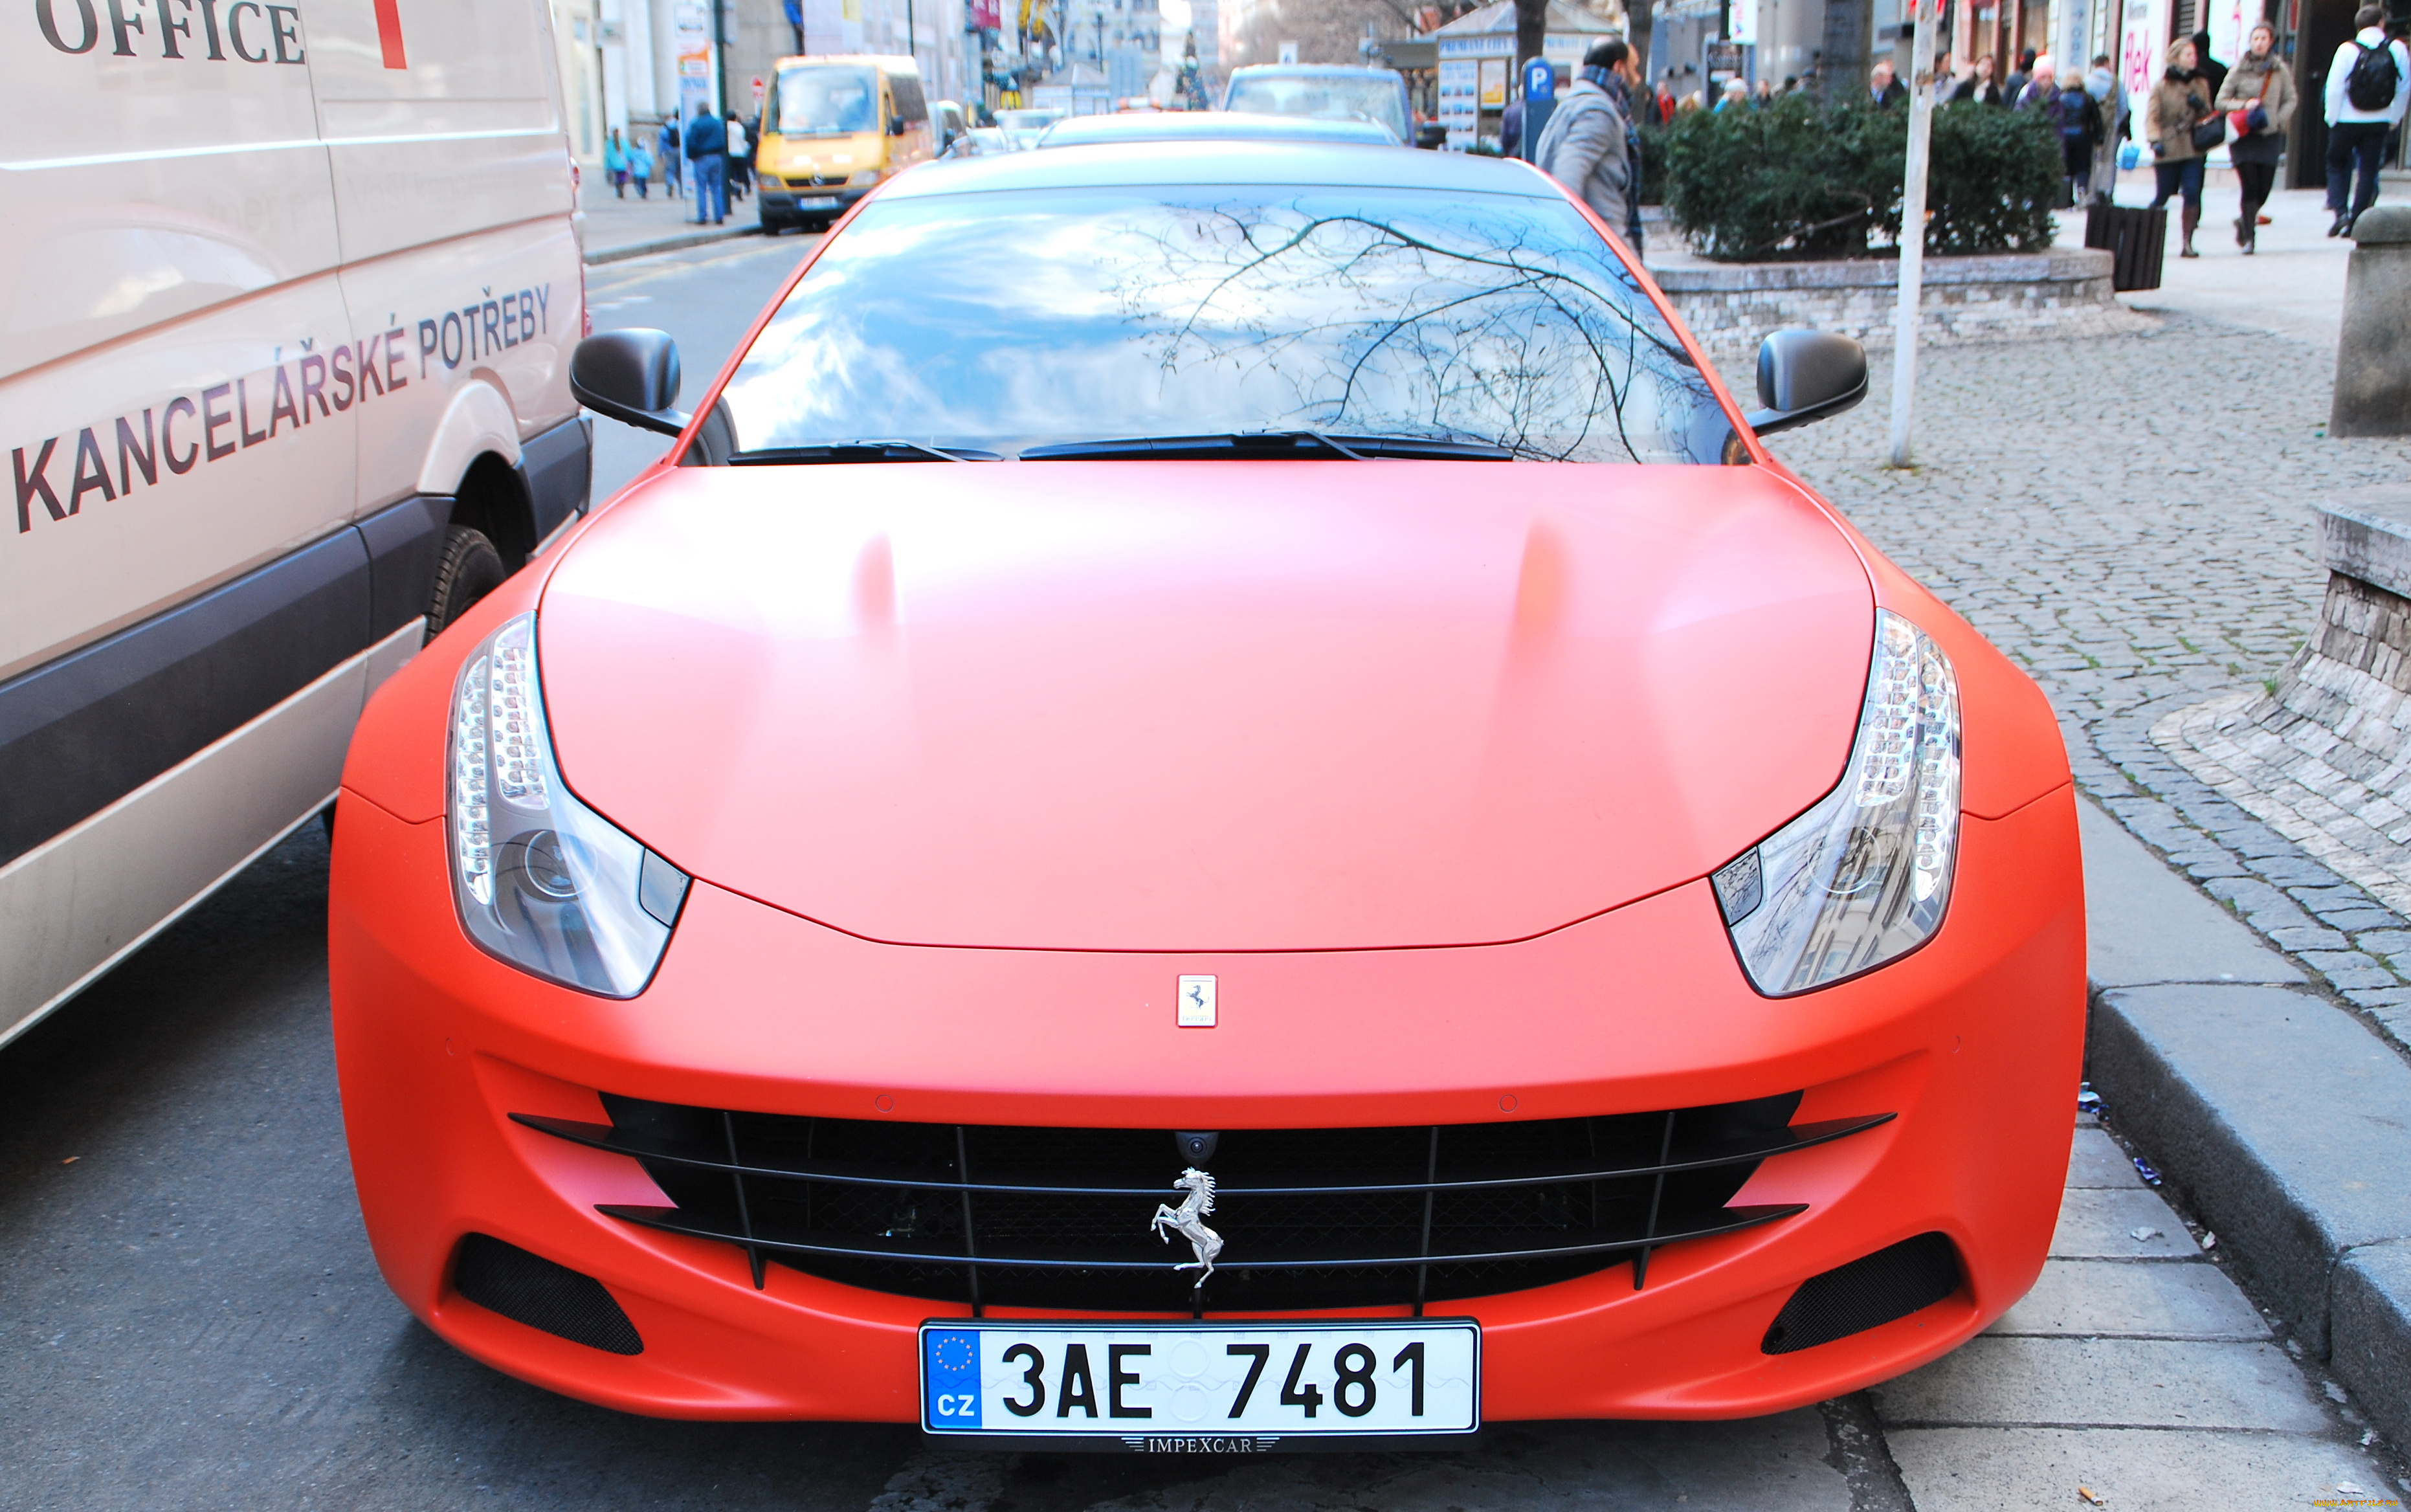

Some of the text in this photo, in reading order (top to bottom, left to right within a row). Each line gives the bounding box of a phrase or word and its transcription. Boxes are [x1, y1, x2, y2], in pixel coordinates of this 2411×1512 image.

[36, 0, 306, 65] OFFICE
[1531, 67, 1548, 92] P
[11, 283, 550, 534] KANCELÁŘSKÉ POTŘEBY
[1003, 1342, 1424, 1418] 3AE 7481
[938, 1394, 974, 1417] CZ
[1149, 1438, 1252, 1452] IMPEXCAR
